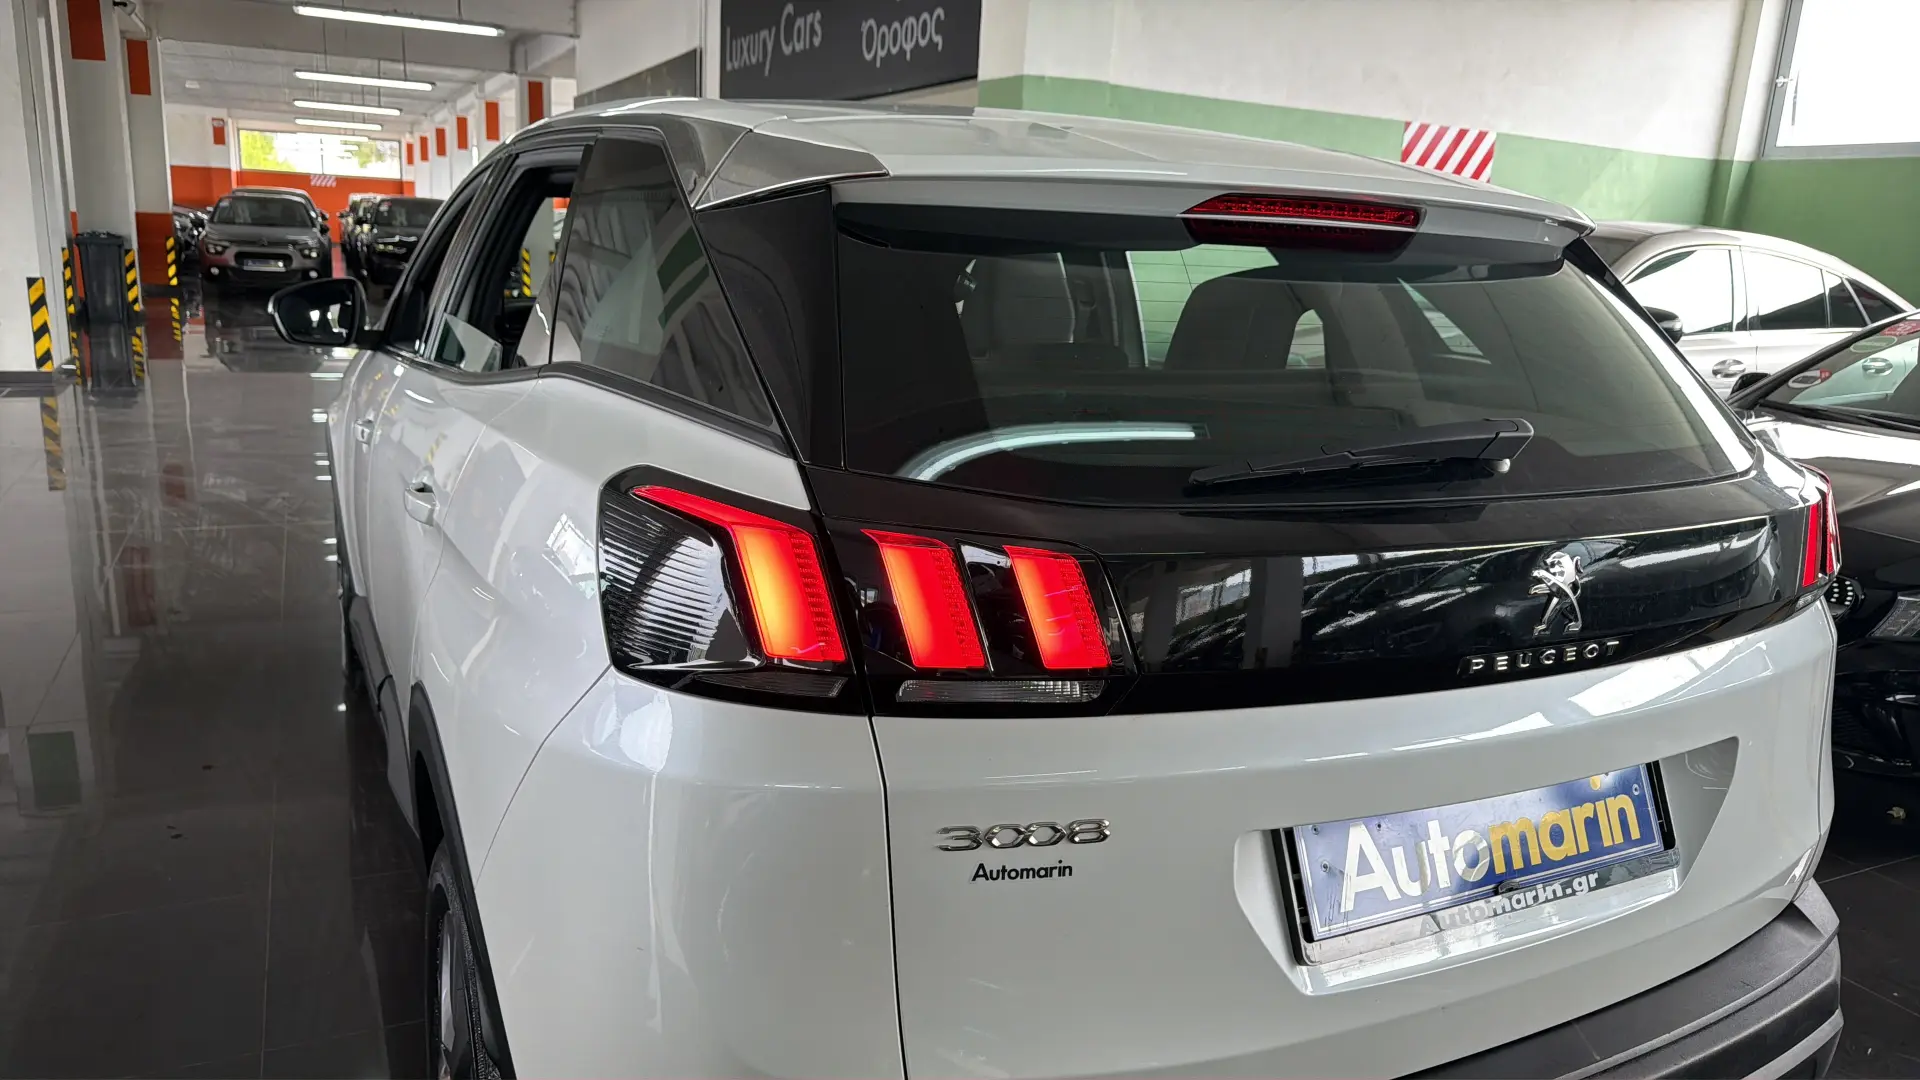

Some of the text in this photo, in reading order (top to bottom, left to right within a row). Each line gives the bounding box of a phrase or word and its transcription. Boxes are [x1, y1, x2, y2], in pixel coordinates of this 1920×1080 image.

[725, 3, 823, 77] Luxury Cars
[860, 7, 945, 68] Όροφος
[1468, 640, 1620, 674] PEUGEOT
[936, 818, 1111, 851] 3008
[1340, 774, 1640, 913] Automarin
[971, 859, 1073, 882] Automarin
[1420, 870, 1599, 935] Automarin.gr
